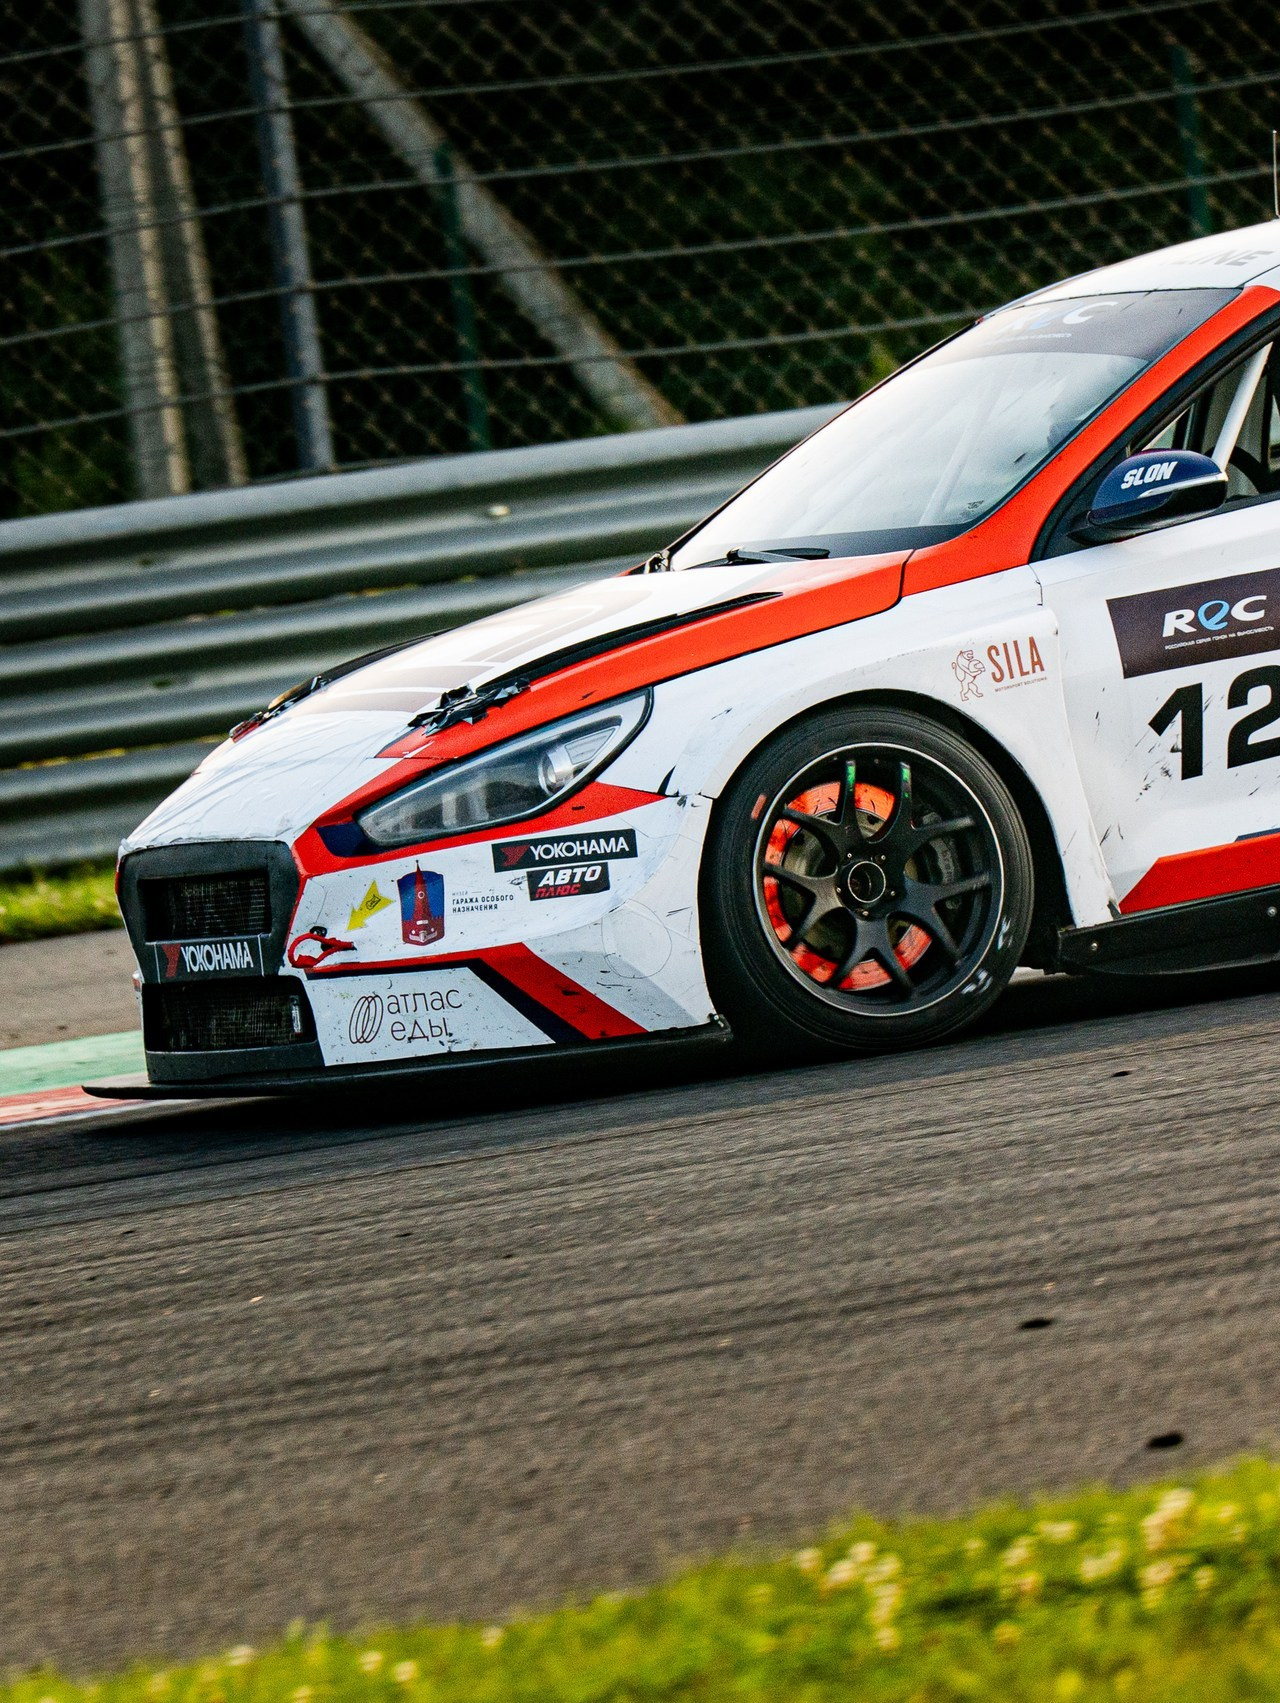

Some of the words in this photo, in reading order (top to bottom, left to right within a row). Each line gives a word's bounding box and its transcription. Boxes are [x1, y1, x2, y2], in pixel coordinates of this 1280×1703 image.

[1120, 461, 1178, 490] SLON
[987, 636, 1045, 683] SILA
[530, 836, 630, 861] YOKOHAMA
[538, 865, 602, 888] АВТО
[452, 897, 479, 905] ГАРАЖА
[481, 894, 514, 902] ОСОБОГО
[535, 884, 581, 898] ПЛЮС
[452, 904, 498, 913] НАЗНАЧЕНИЯ
[180, 941, 254, 972] YOKOHAMA
[387, 989, 463, 1015] атлас
[391, 1017, 449, 1041] еды
